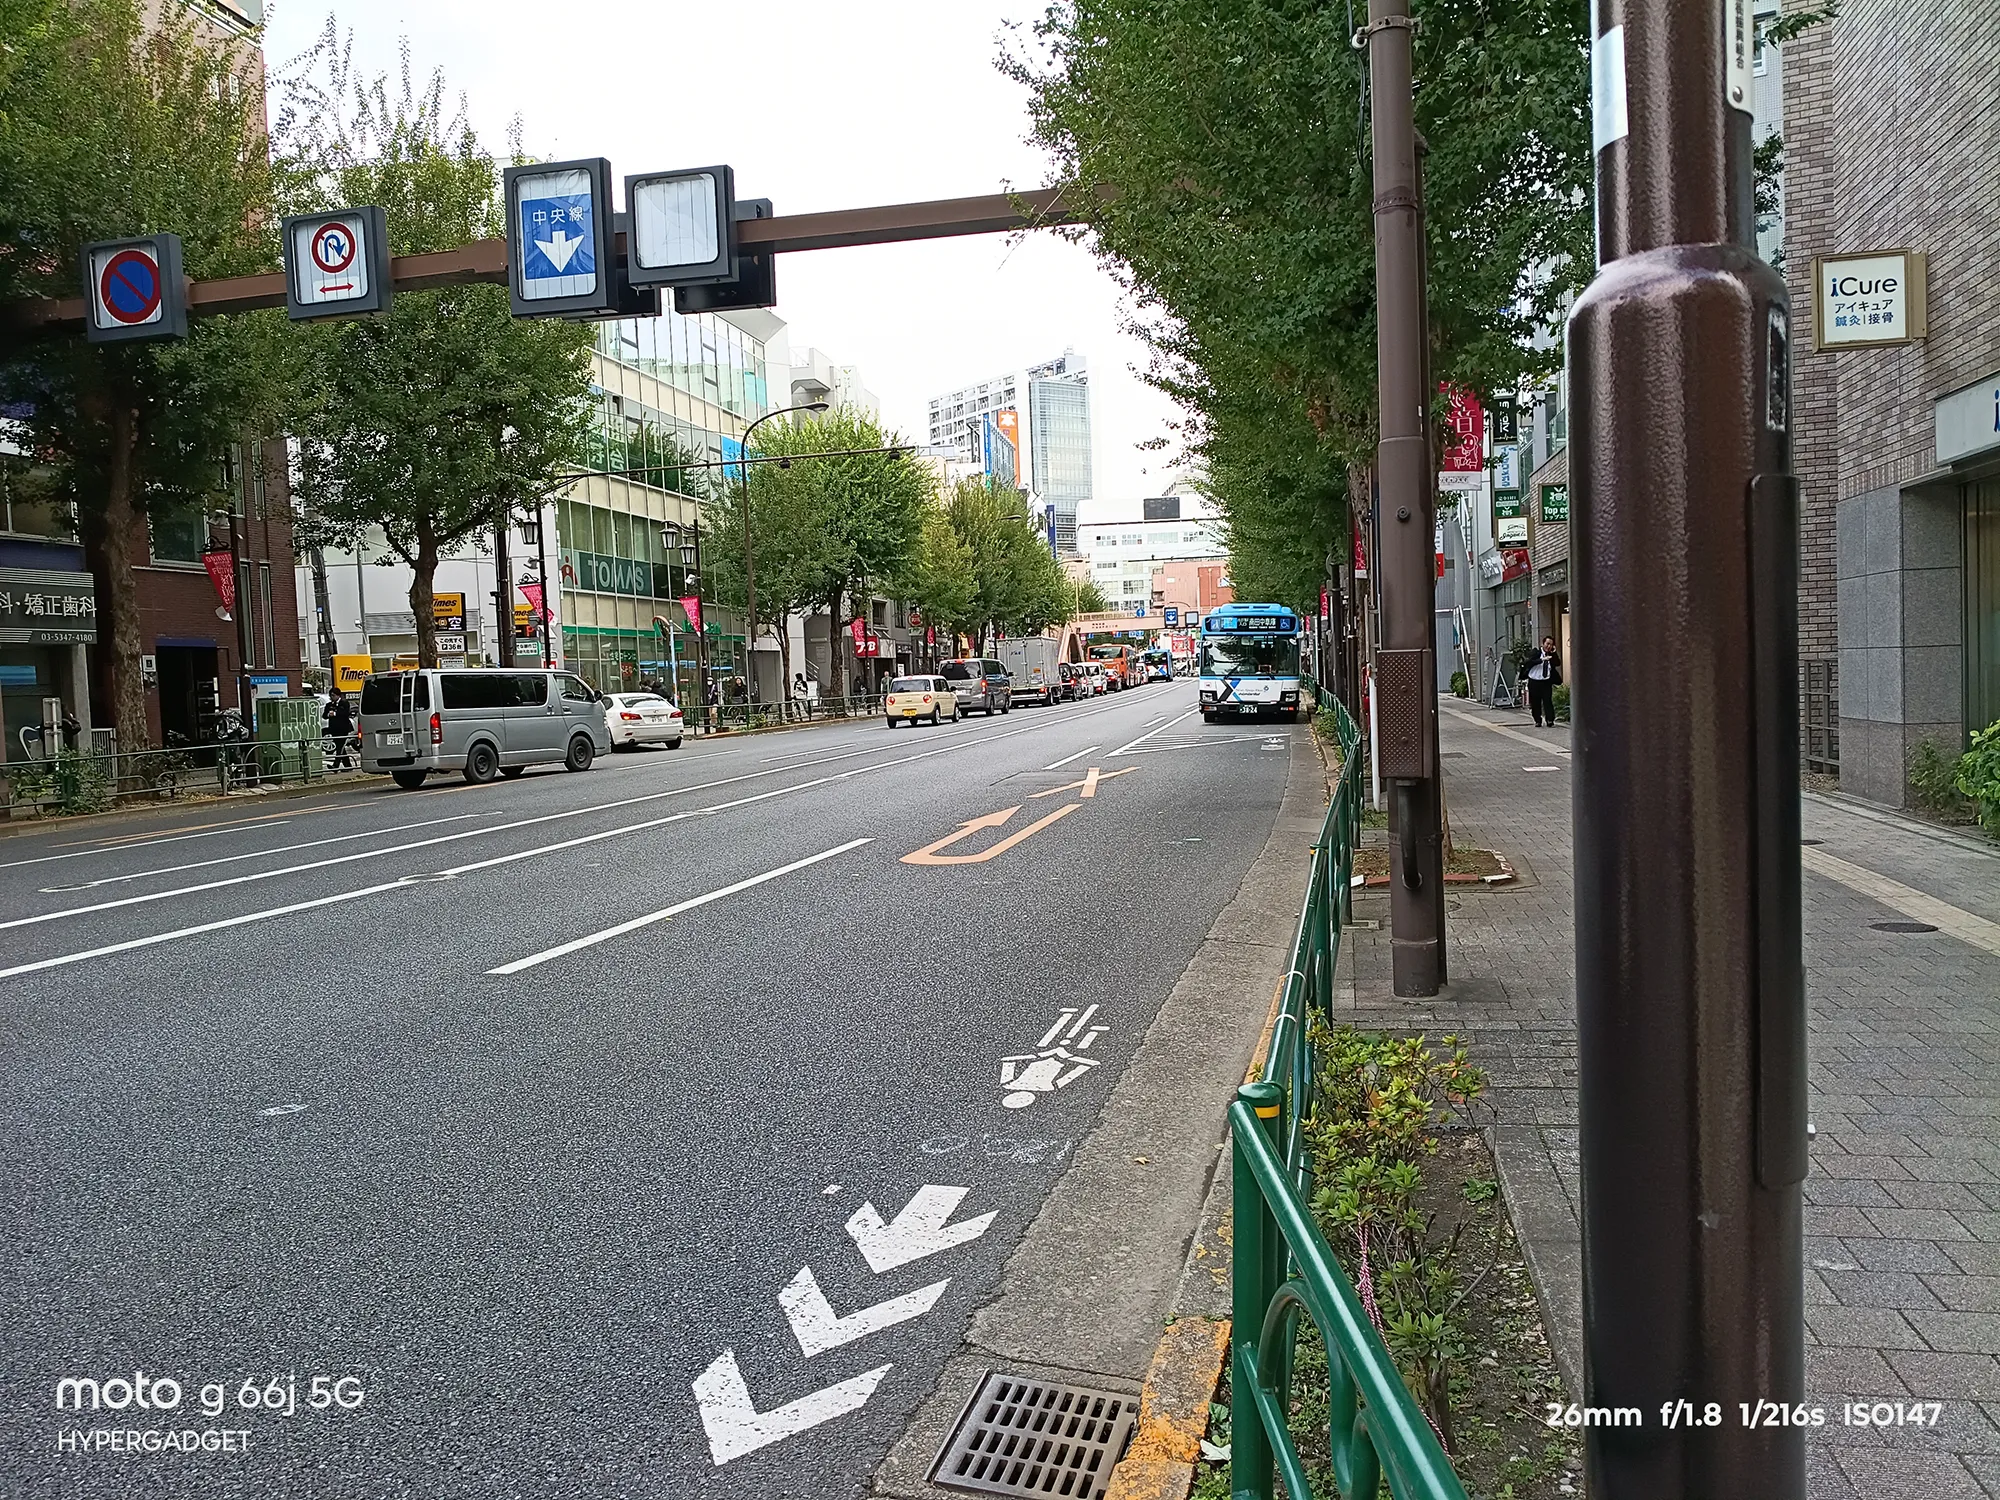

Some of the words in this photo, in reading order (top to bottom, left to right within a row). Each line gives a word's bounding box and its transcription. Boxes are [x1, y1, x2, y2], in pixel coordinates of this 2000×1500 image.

[532, 205, 584, 225] 中央線
[1830, 277, 1898, 297] iCure
[1834, 299, 1894, 314] アイキュア
[1543, 506, 1558, 515] Top
[587, 559, 645, 591] TOMAS
[448, 616, 462, 630] 空
[41, 633, 93, 642] 03-5347-4180
[340, 667, 370, 680] Times
